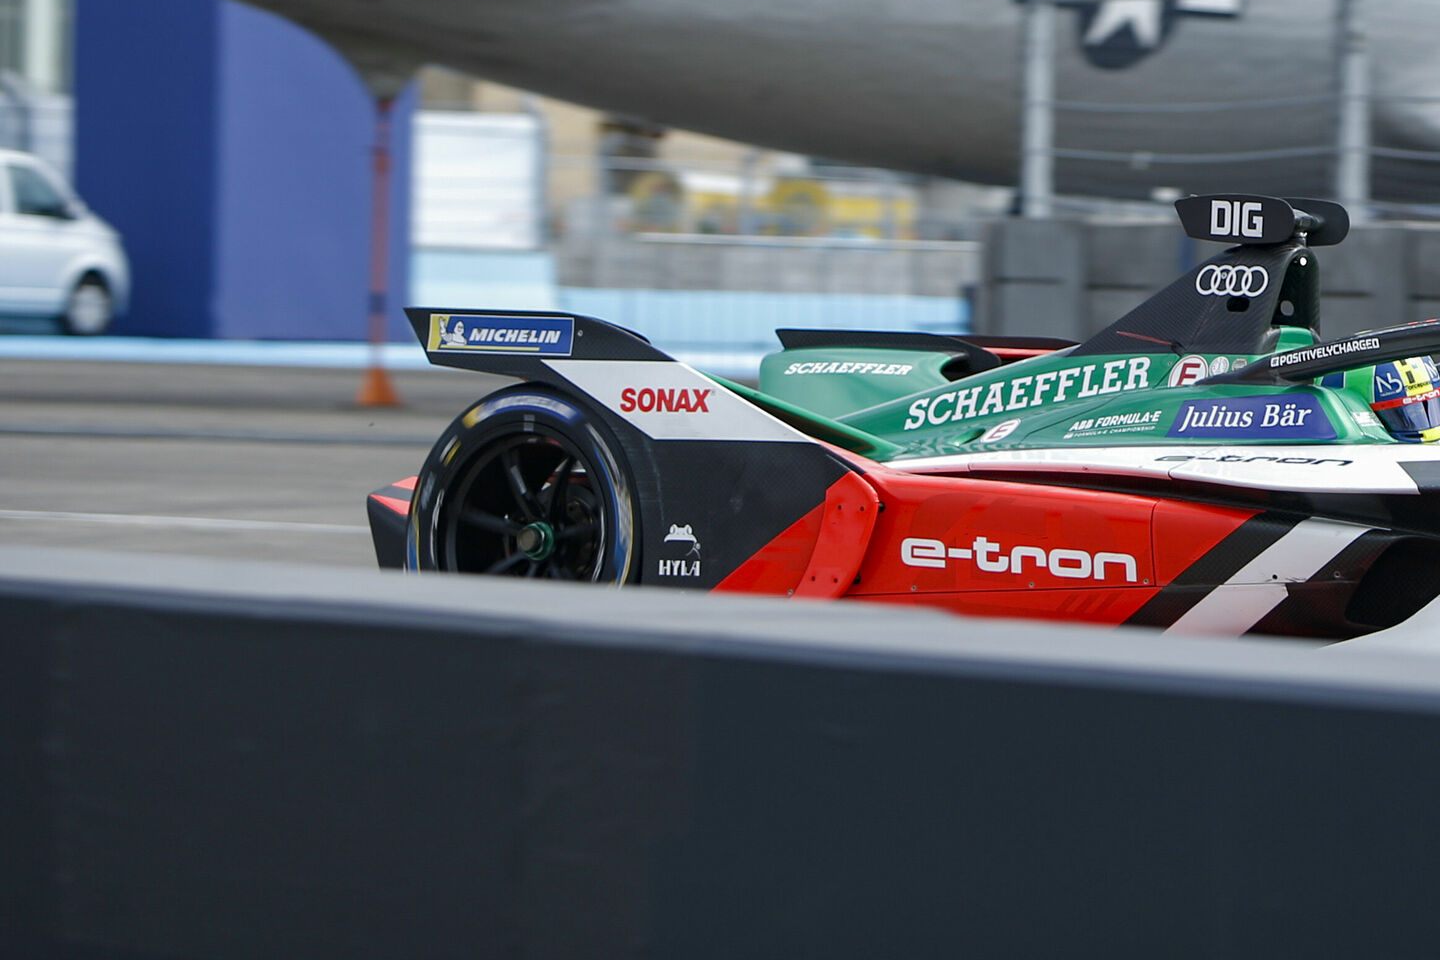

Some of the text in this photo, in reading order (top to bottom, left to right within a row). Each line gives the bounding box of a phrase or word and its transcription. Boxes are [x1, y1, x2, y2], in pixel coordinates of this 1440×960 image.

[1210, 200, 1263, 237] DIG
[469, 327, 561, 344] MICHELIN
[784, 361, 913, 376] SCHAEFFLER
[620, 388, 711, 412] SONAX
[904, 356, 1151, 431] SCHAEFFLER
[1402, 390, 1440, 405] e-tron
[1069, 419, 1095, 432] ABB
[1179, 403, 1312, 432] Julius Bär
[1154, 455, 1354, 467] e-tron
[659, 559, 701, 577] HYLA
[901, 536, 1137, 582] e-tron
